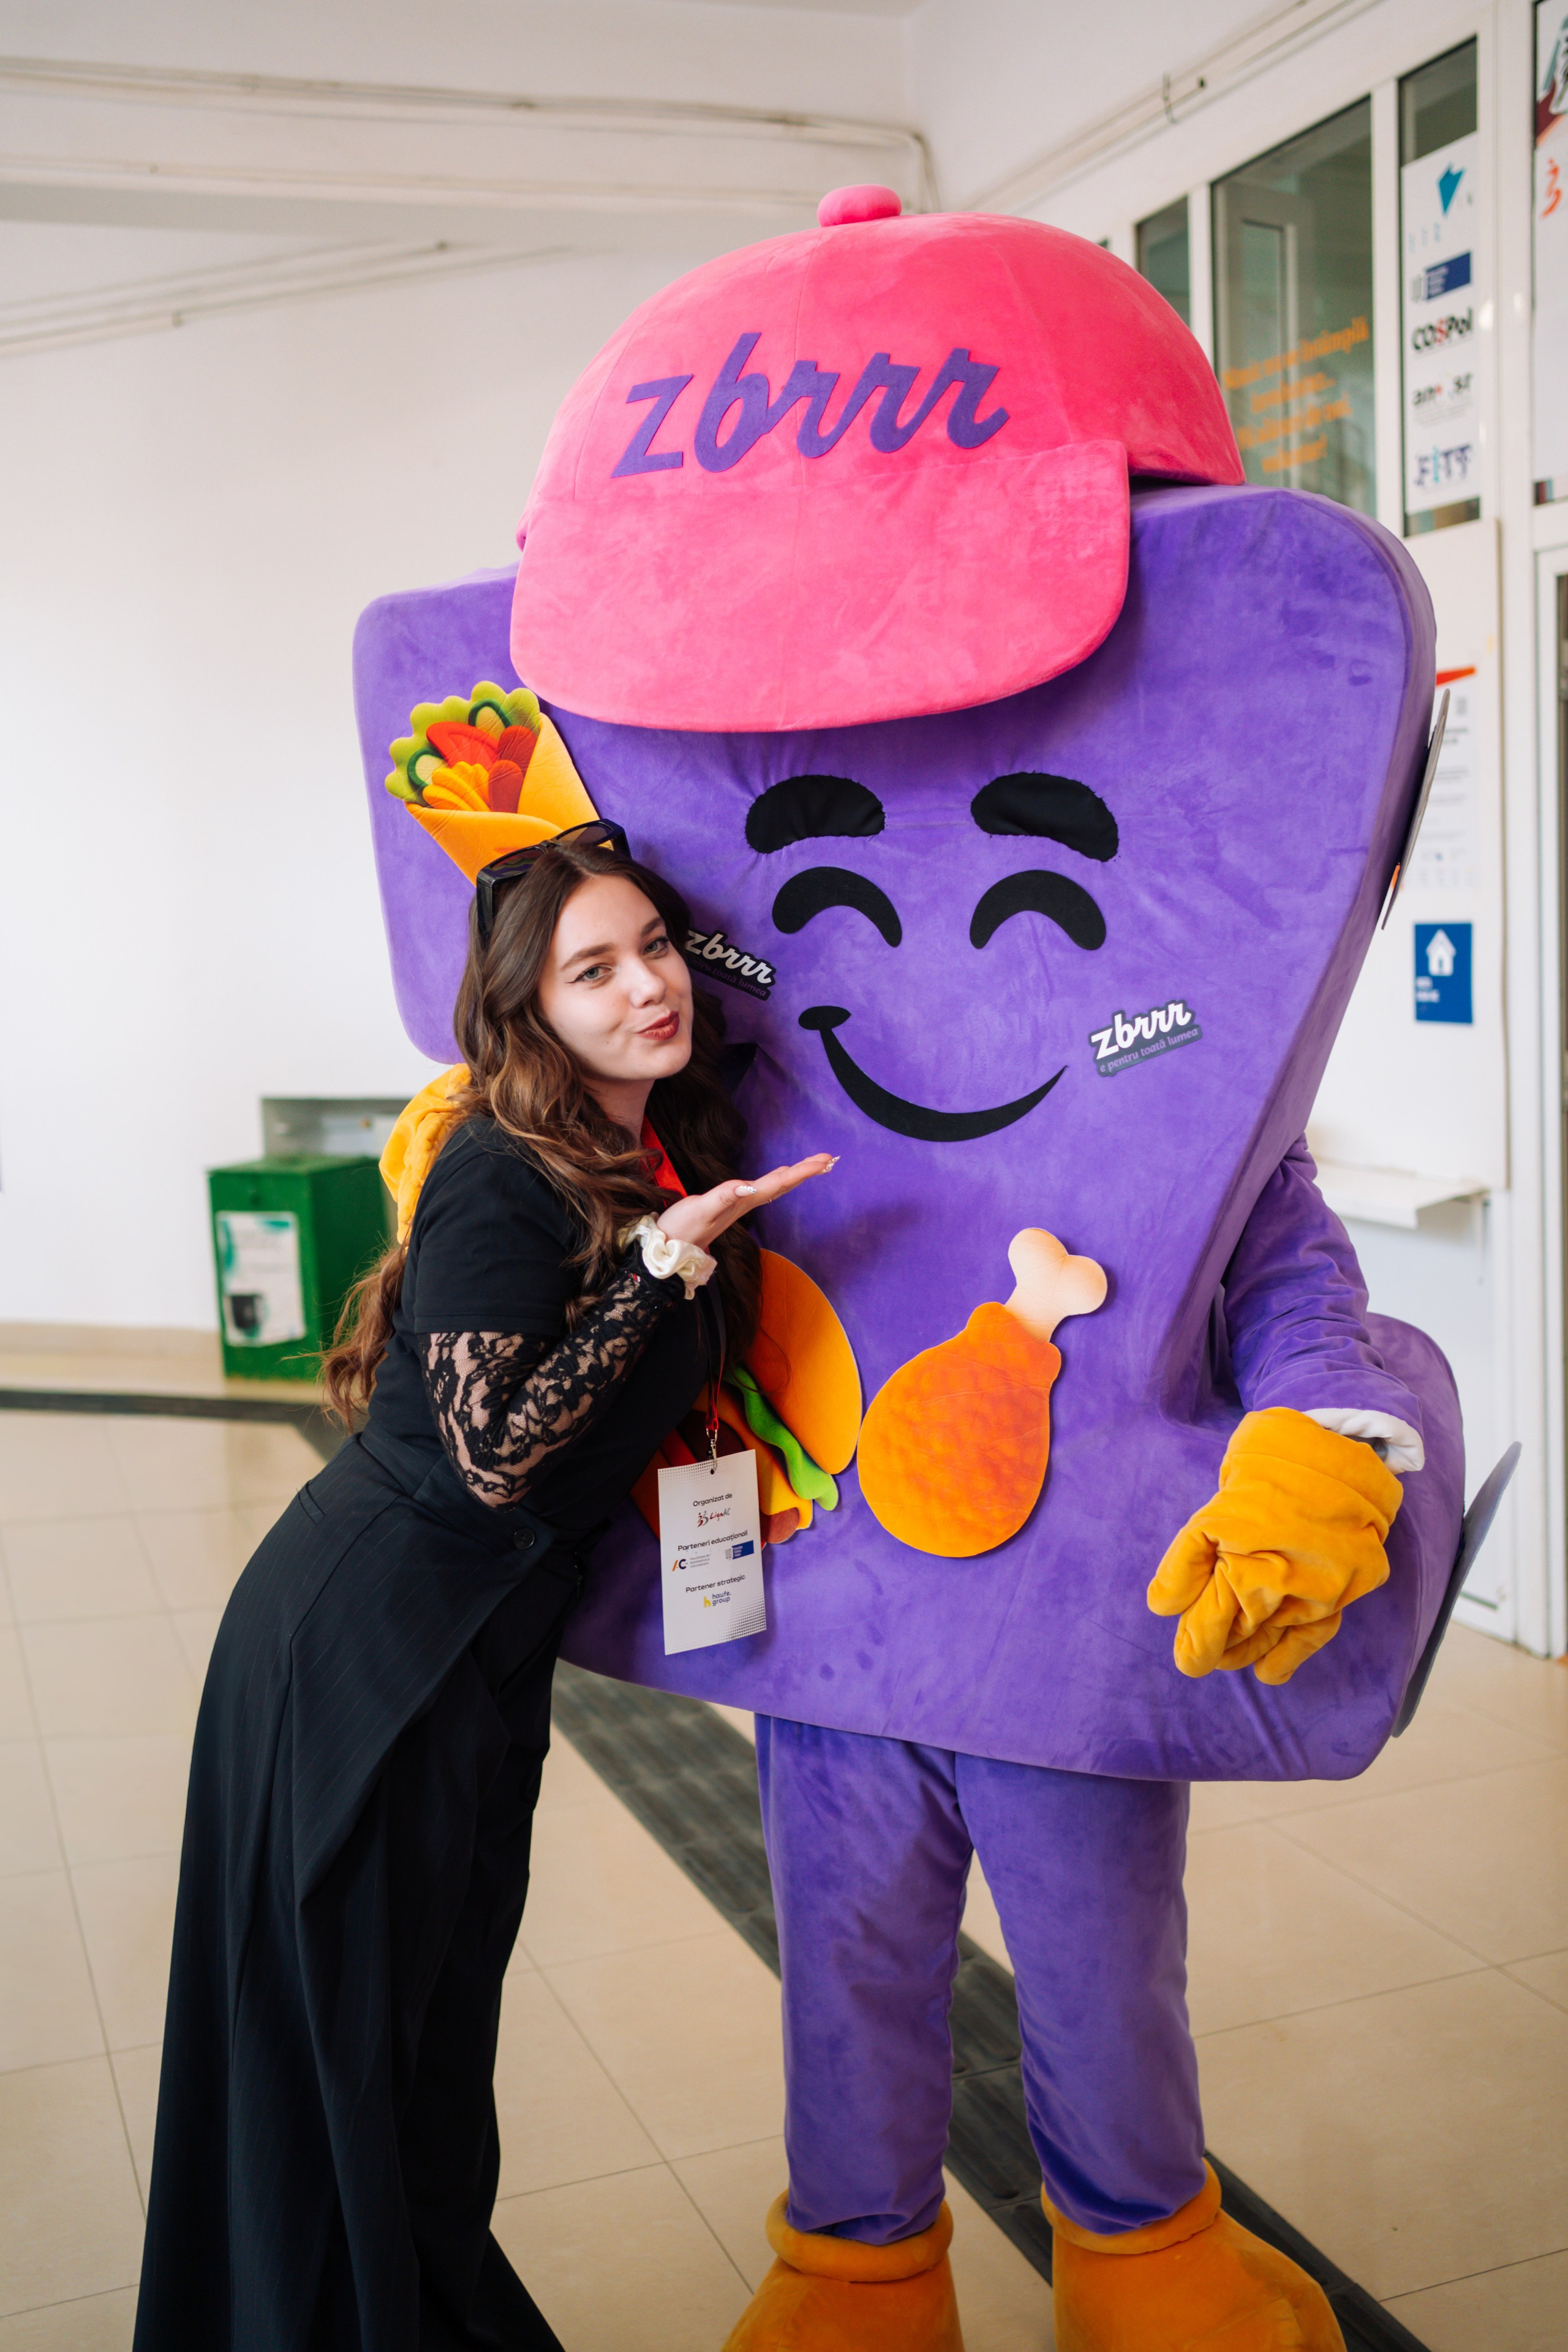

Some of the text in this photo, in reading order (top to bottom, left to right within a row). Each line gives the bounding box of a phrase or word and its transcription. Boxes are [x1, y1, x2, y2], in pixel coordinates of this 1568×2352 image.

[611, 333, 1009, 478] zbrrr
[685, 930, 772, 984] zbrrr
[739, 979, 766, 997] lumea
[1091, 1003, 1192, 1060] zbrrr
[1107, 1051, 1139, 1072] pentru
[1140, 1039, 1166, 1057] toată
[1167, 1028, 1199, 1046] lumea
[693, 1494, 725, 1507] Organizat
[678, 1539, 710, 1551] Parteneri
[685, 1574, 745, 1593] Partener strategic
[712, 1597, 730, 1606] group
